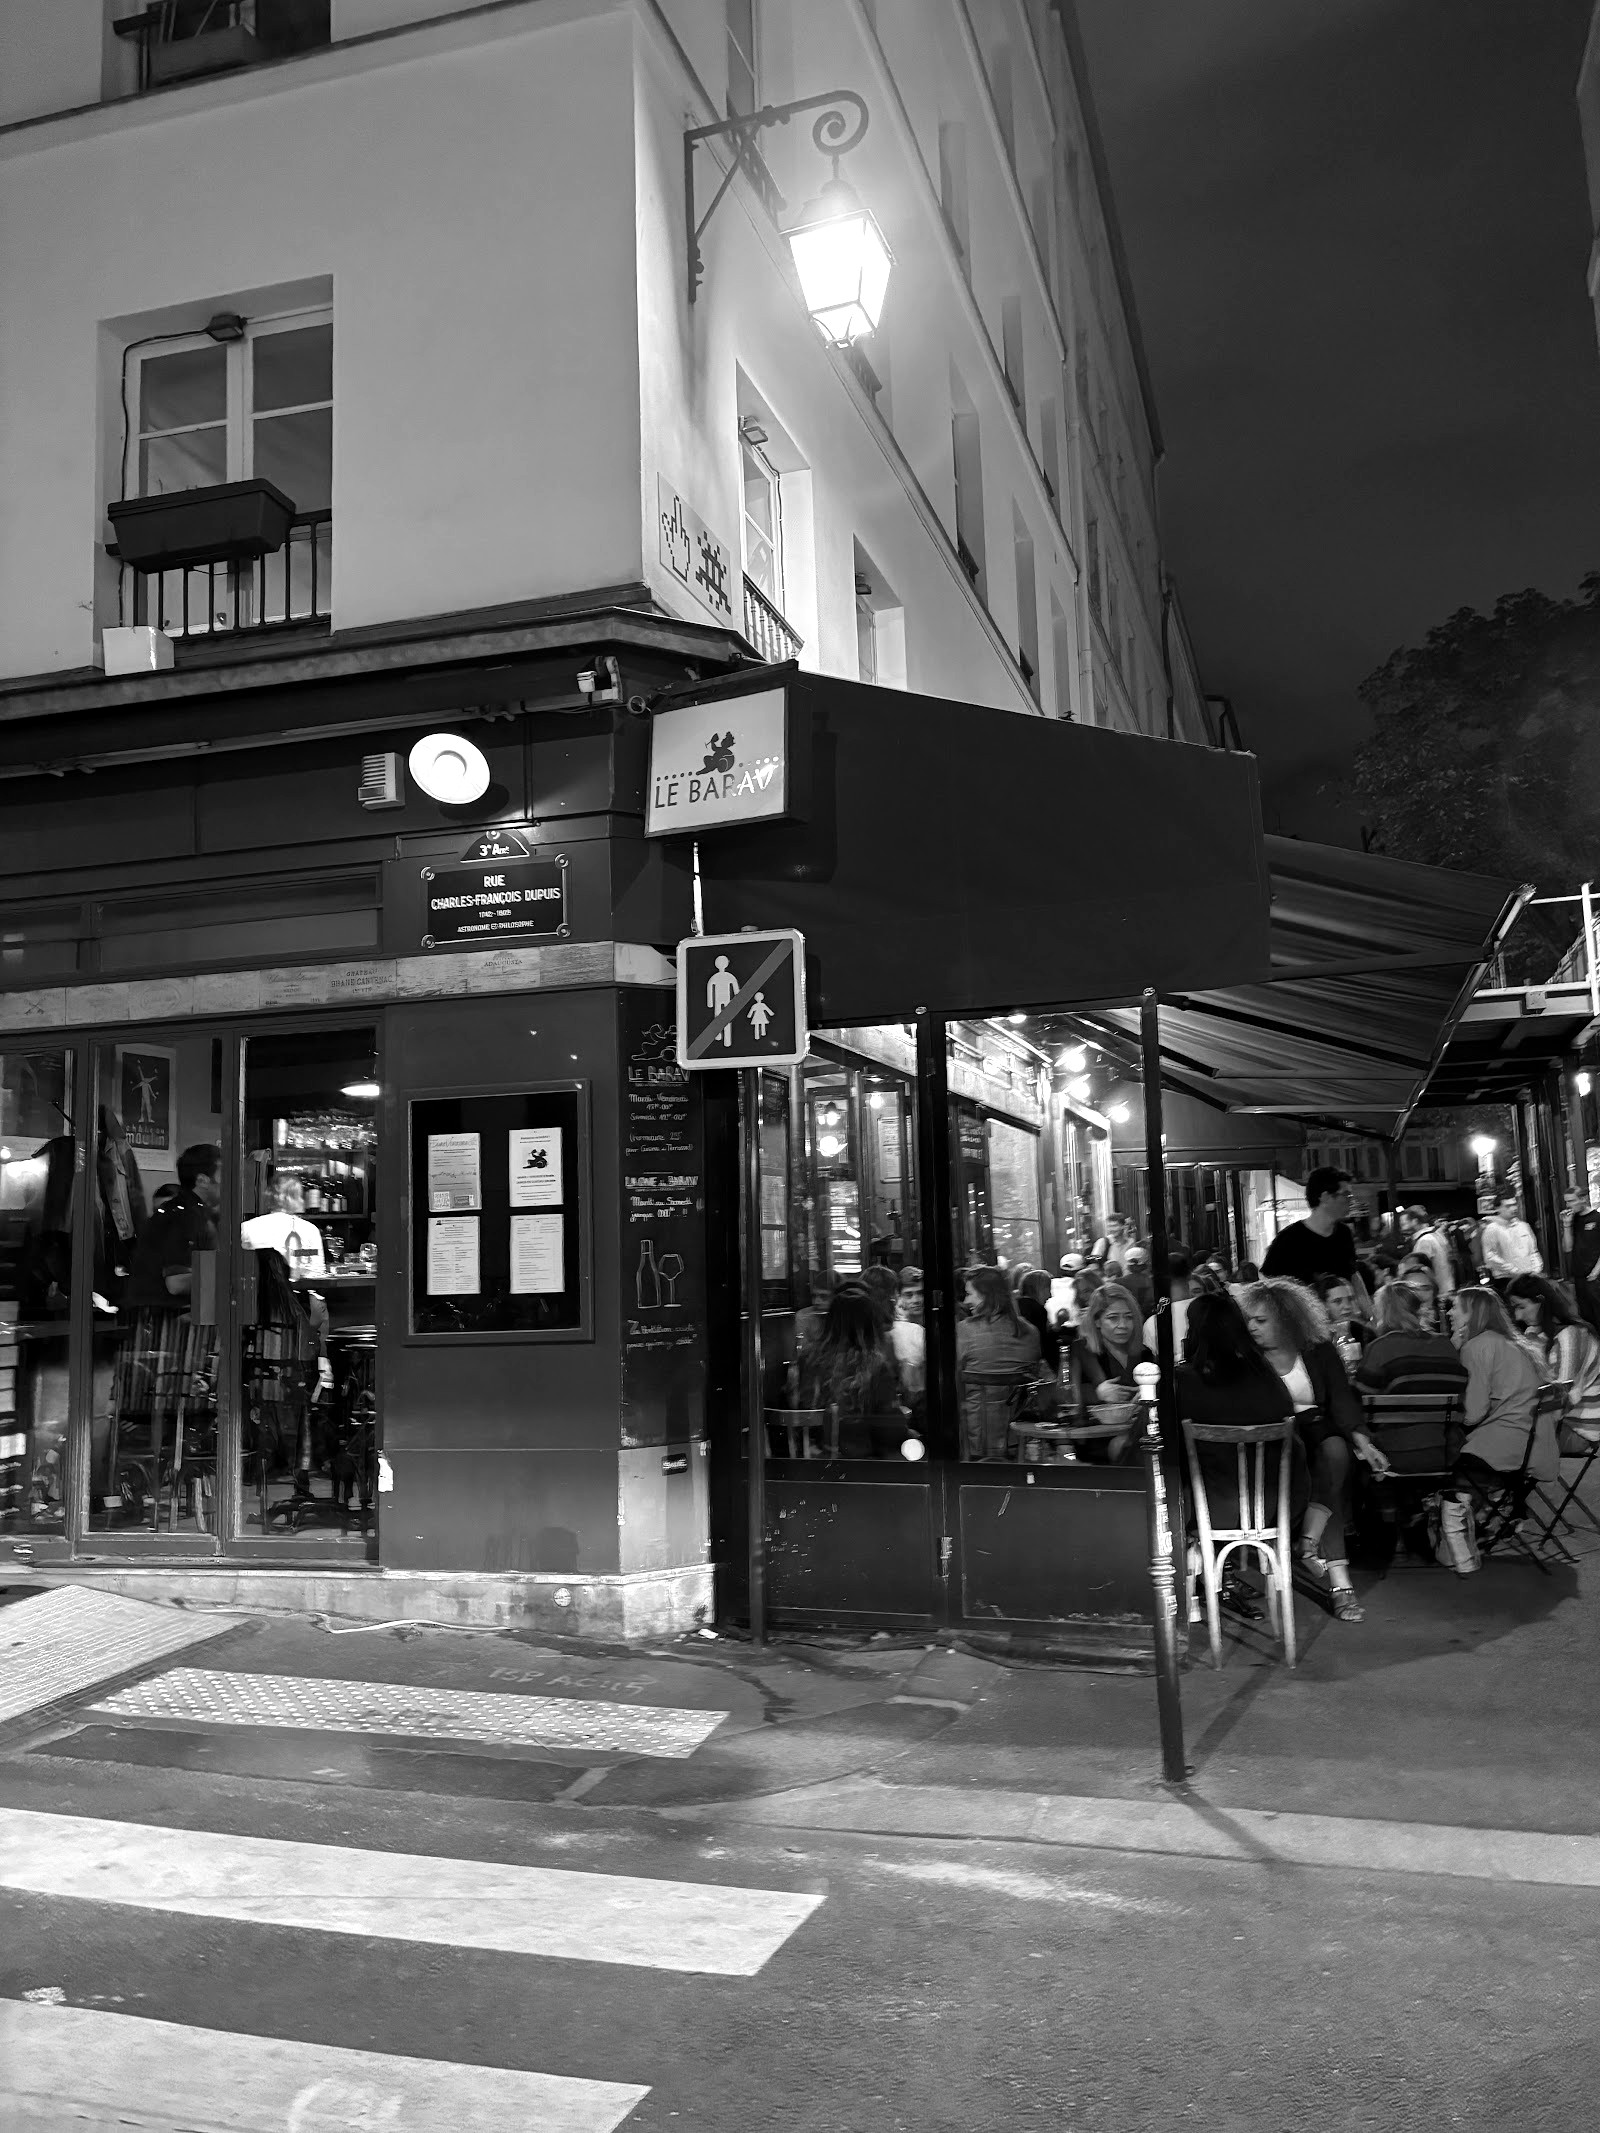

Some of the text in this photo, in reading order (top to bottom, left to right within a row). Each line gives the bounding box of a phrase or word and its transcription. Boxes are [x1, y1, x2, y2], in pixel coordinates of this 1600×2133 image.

[655, 764, 779, 808] LE BARAV
[483, 874, 506, 888] RUE
[430, 887, 561, 910] CHARLES-FRANÇOIS DUPUIS
[457, 923, 491, 933] ASTRONOME
[498, 920, 535, 930] PHILOSOPHE
[125, 1132, 165, 1147] moulin
